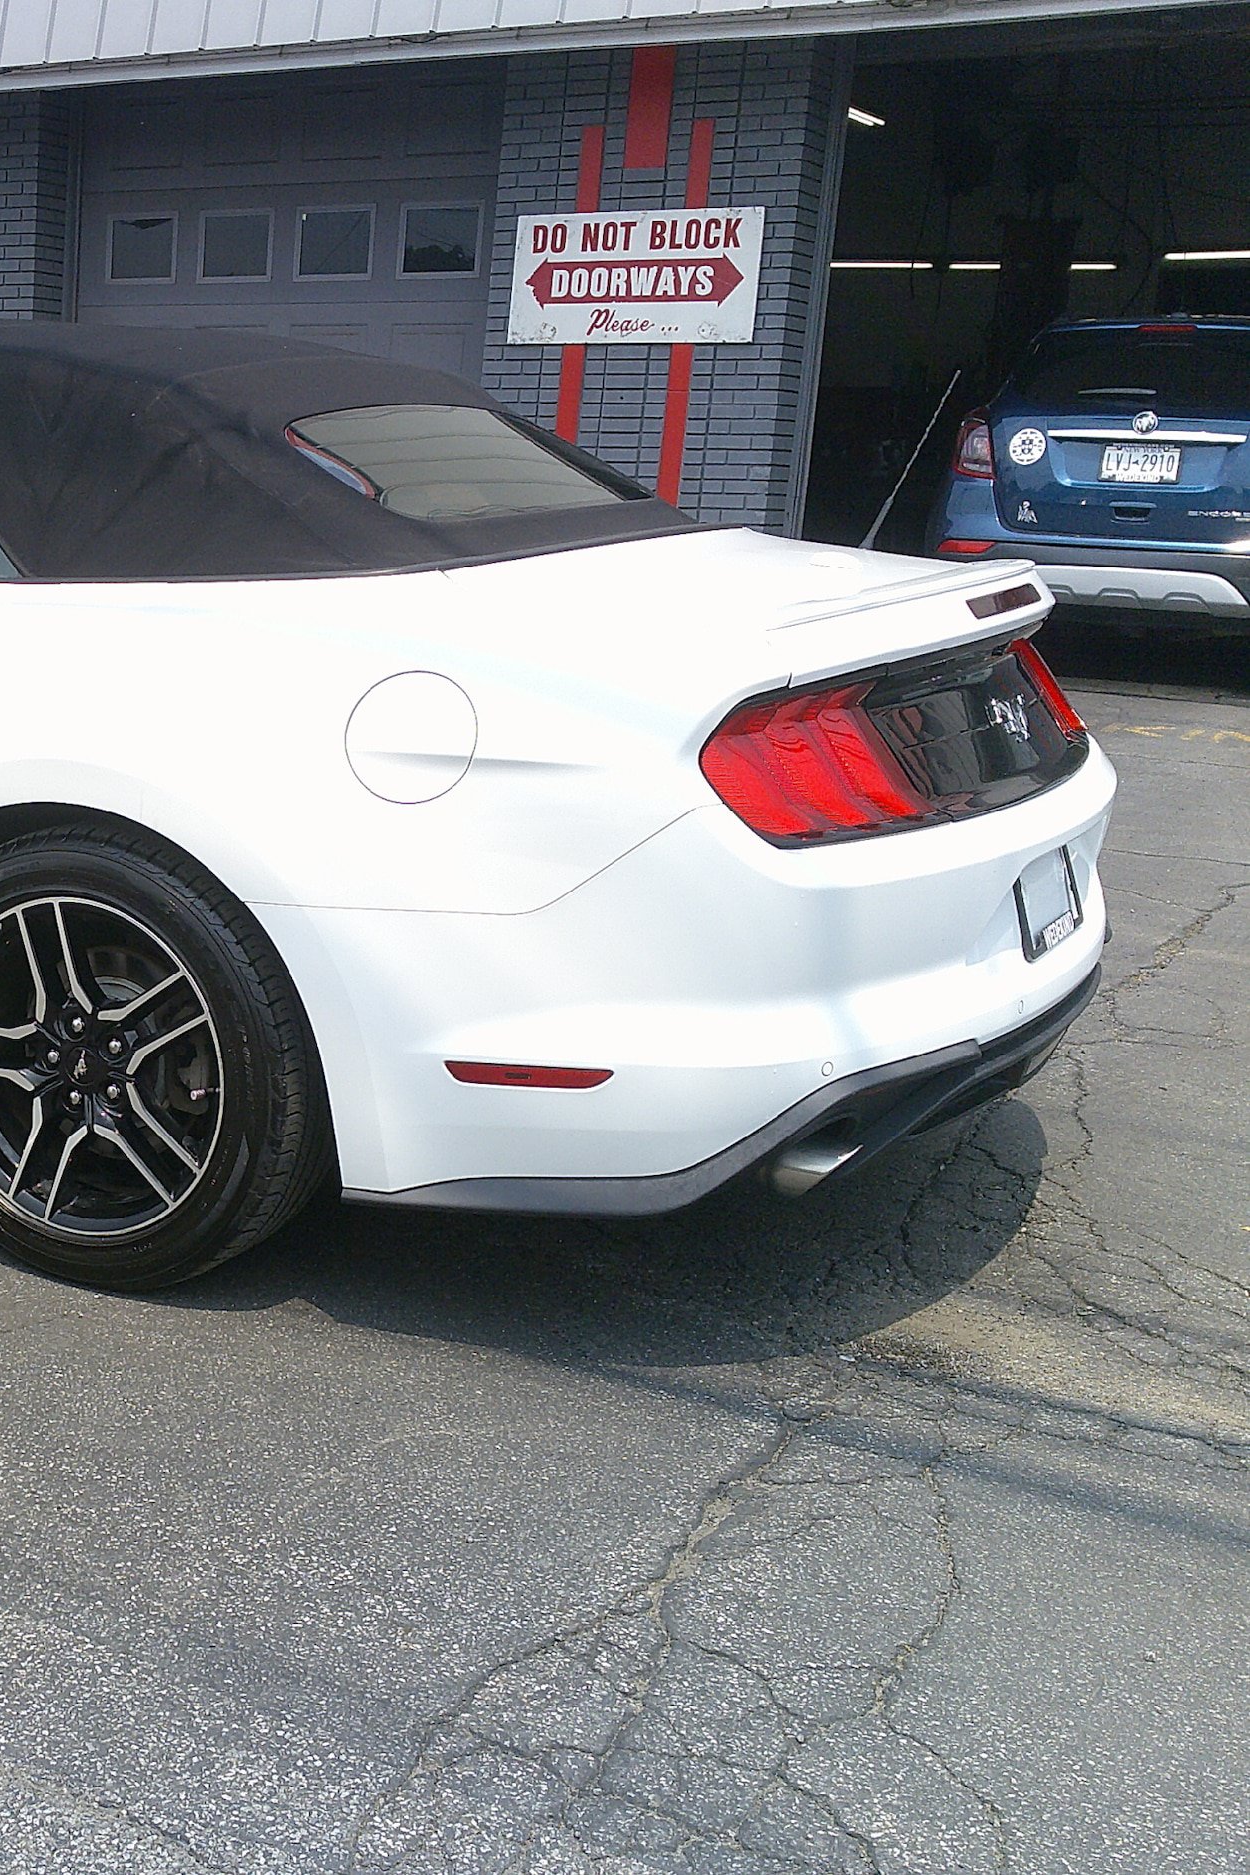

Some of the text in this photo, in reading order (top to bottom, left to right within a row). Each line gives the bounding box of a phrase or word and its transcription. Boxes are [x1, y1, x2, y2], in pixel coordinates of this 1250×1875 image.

[532, 217, 743, 254] DO NOT BLOCK
[550, 265, 715, 299] DOORWAYS
[586, 308, 655, 337] Please
